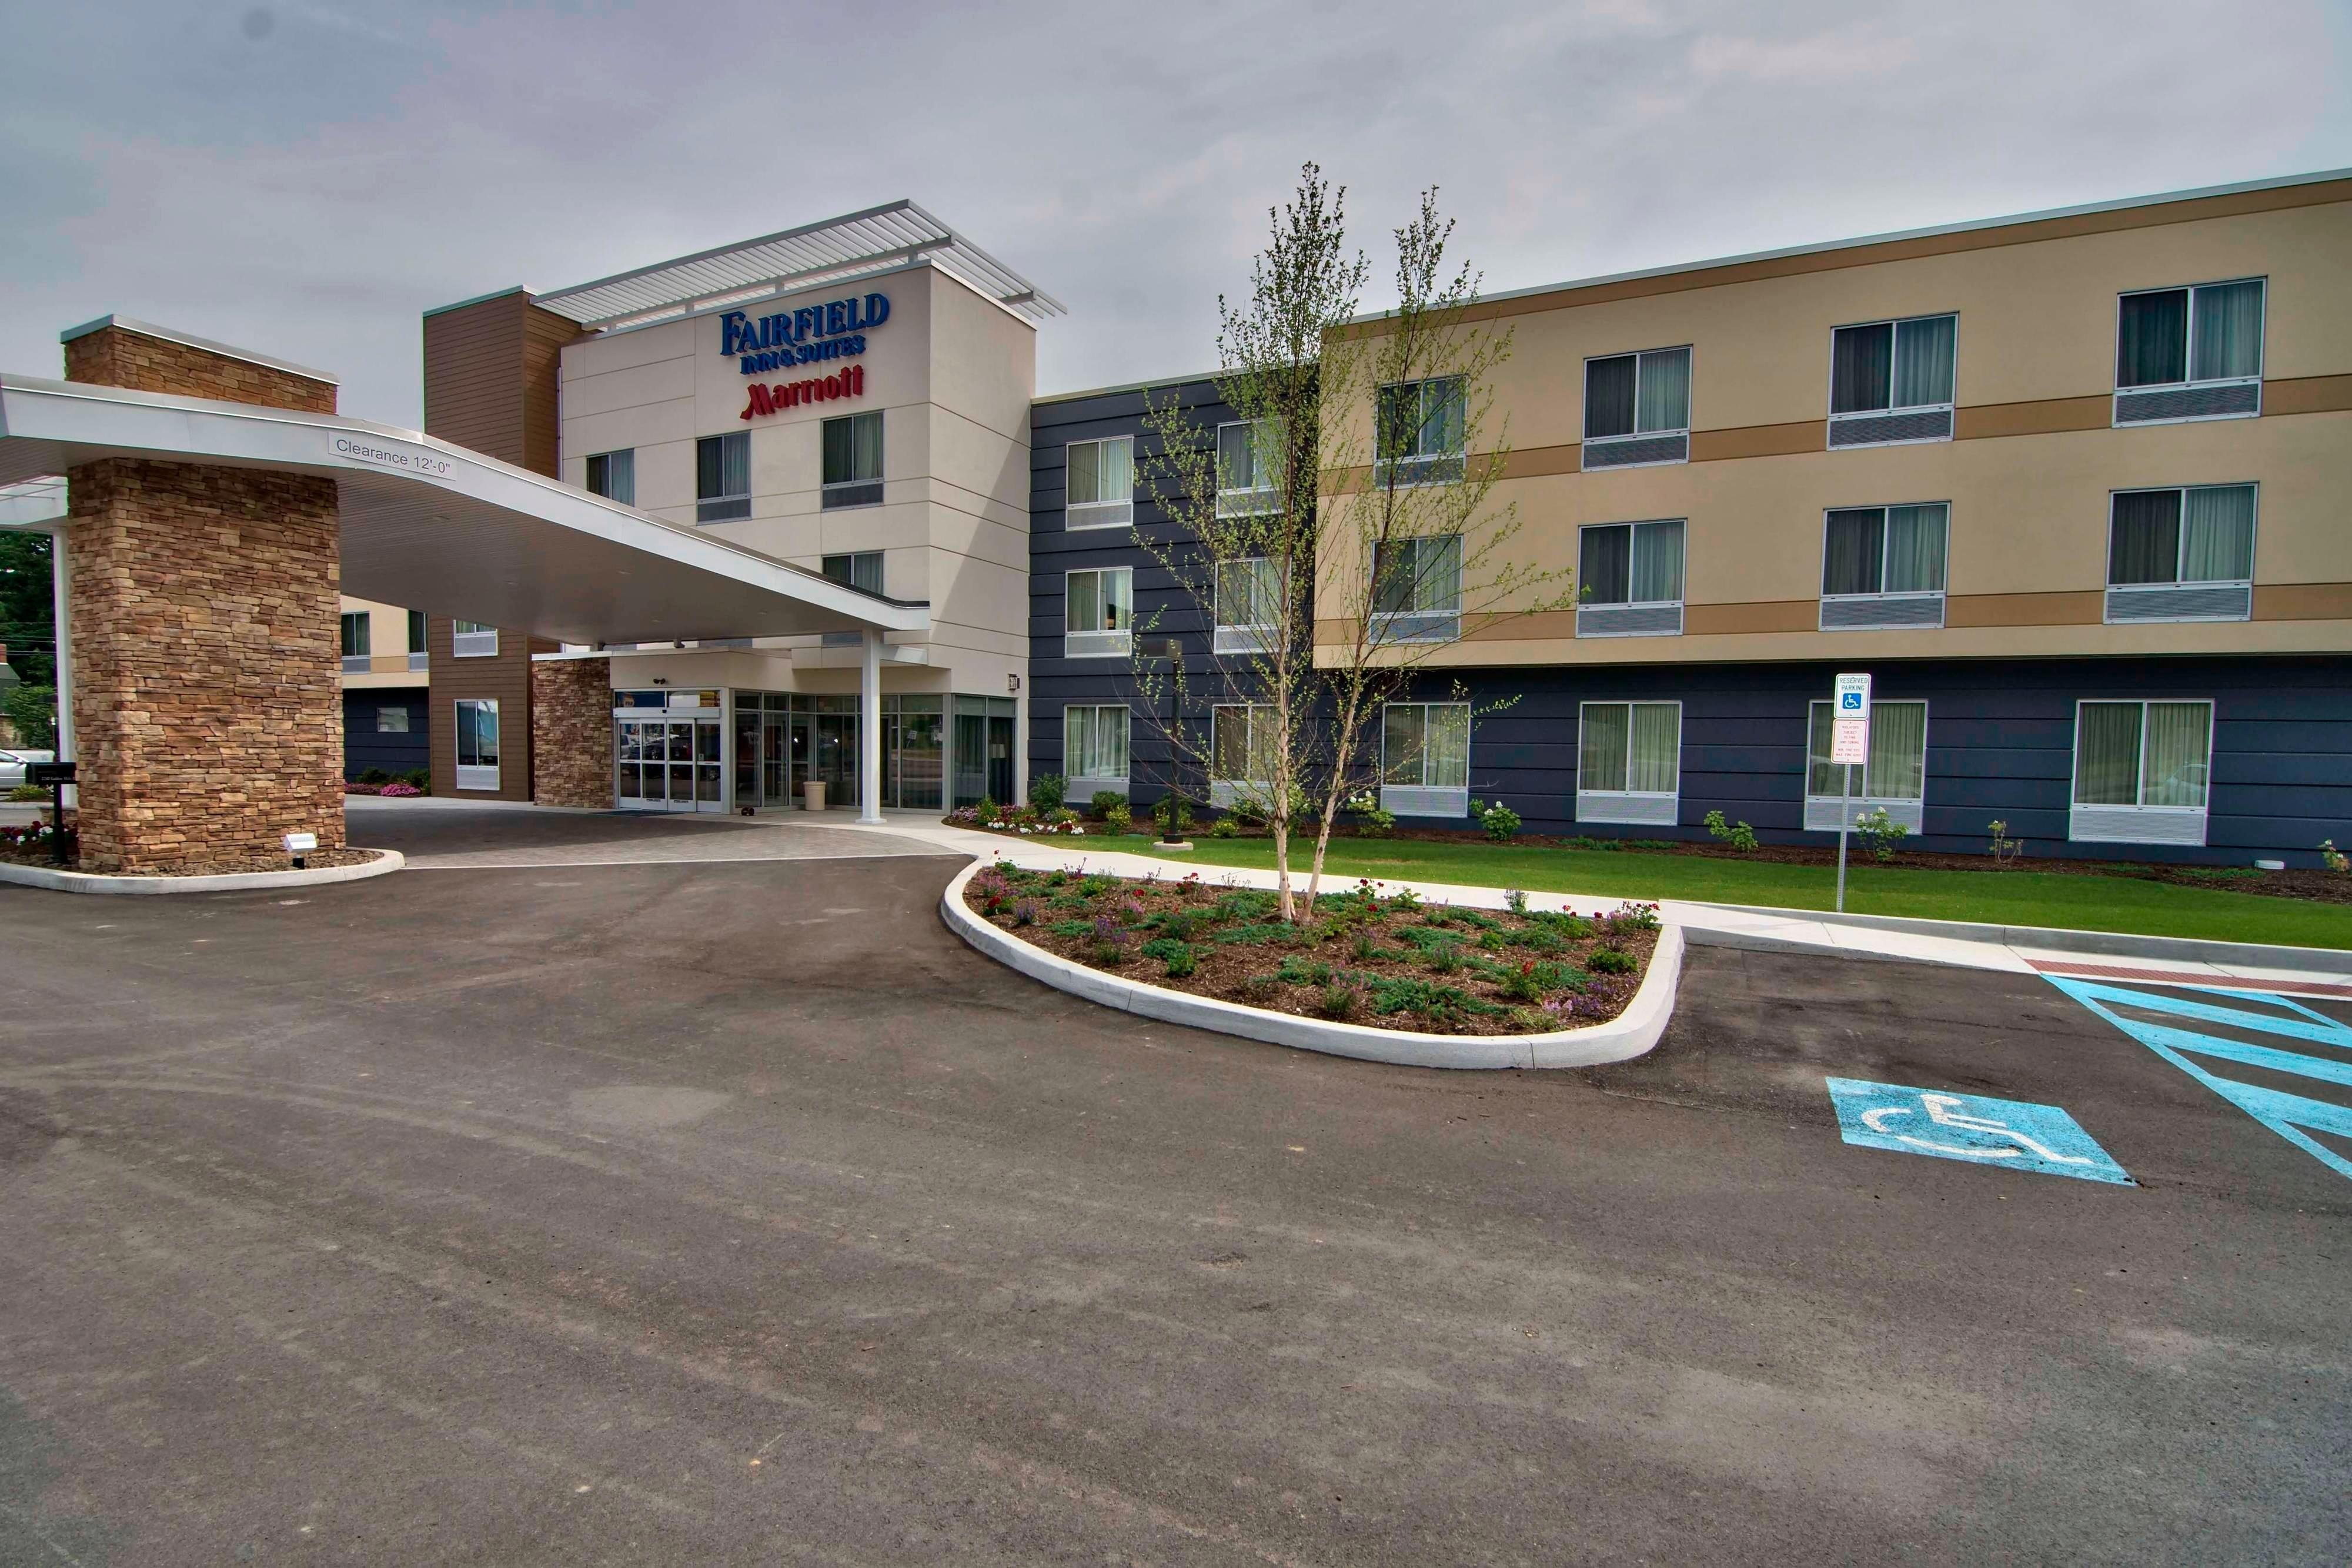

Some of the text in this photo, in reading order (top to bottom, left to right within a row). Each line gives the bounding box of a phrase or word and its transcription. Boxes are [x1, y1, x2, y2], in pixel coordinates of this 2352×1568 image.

[720, 293, 890, 356] FAIRFIELD
[740, 335, 866, 375] INN & SUITES
[740, 364, 864, 420] Marriott
[336, 439, 450, 473] Clearance 12'-0"
